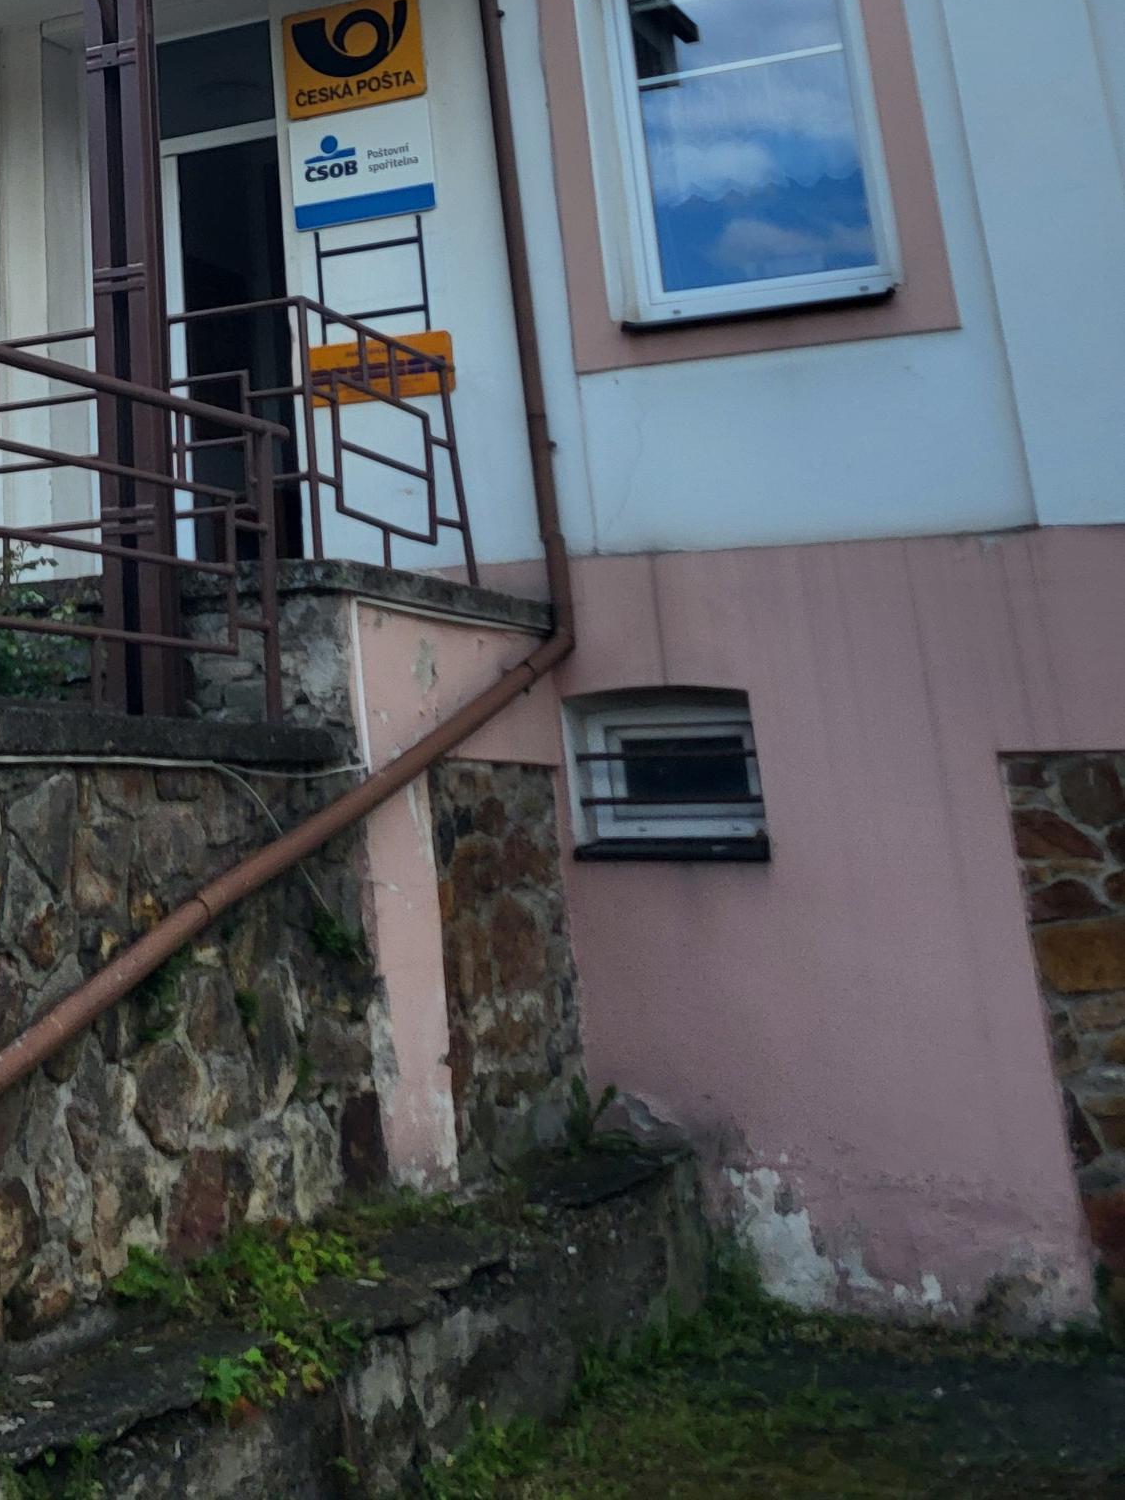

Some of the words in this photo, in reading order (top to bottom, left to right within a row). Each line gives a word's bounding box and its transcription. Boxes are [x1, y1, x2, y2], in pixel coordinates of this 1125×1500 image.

[295, 81, 354, 107] ČESKÁ
[356, 70, 415, 95] POŠTA
[367, 142, 410, 160] Poštovní
[305, 160, 358, 182] ČSOB
[368, 155, 419, 174] spořitelna
